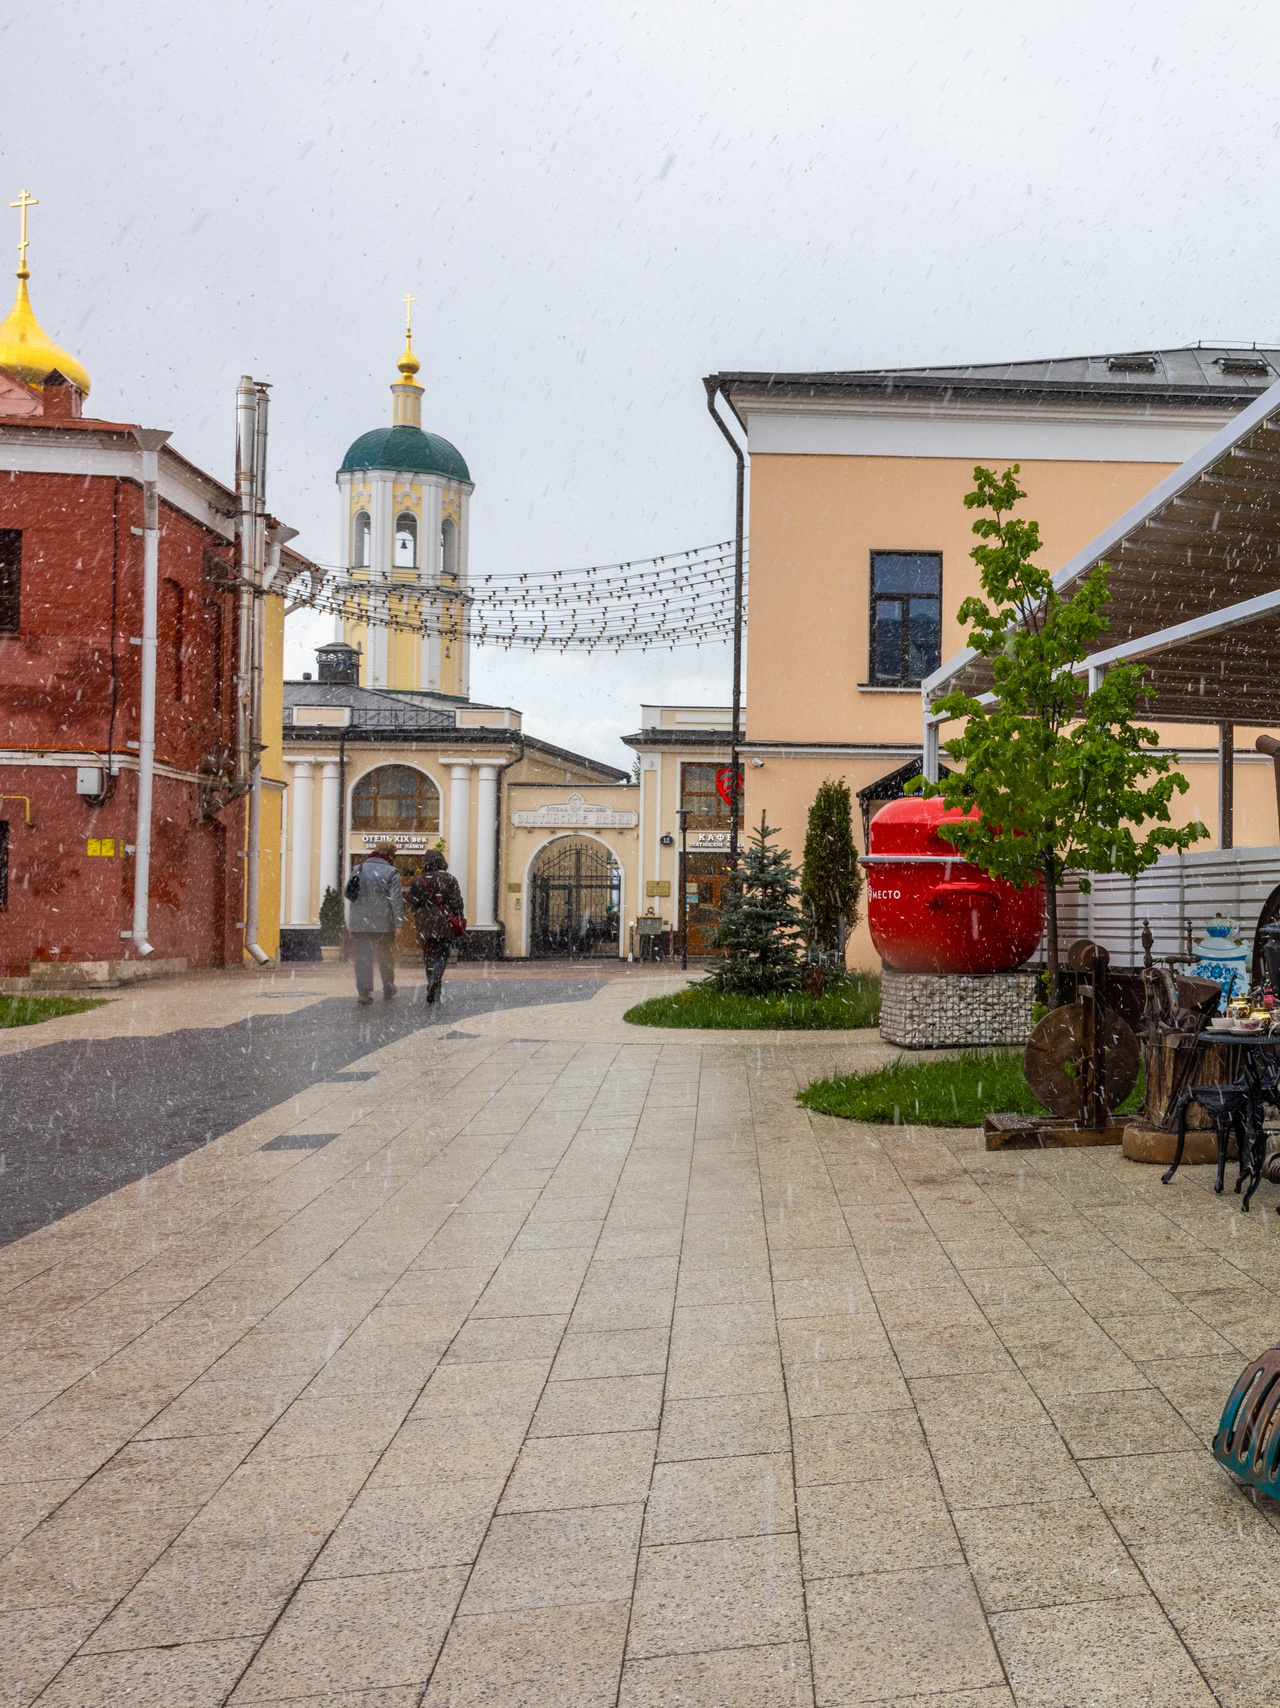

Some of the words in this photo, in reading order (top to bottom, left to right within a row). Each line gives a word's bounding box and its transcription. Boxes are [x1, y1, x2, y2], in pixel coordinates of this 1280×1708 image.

[517, 812, 588, 825] ЗЛАТИНСКИЕ
[595, 813, 632, 826] ЛАВКИ
[362, 835, 392, 843] ОТЕЛЬ
[394, 835, 409, 843] XIX
[872, 890, 901, 900] МЕСТО
